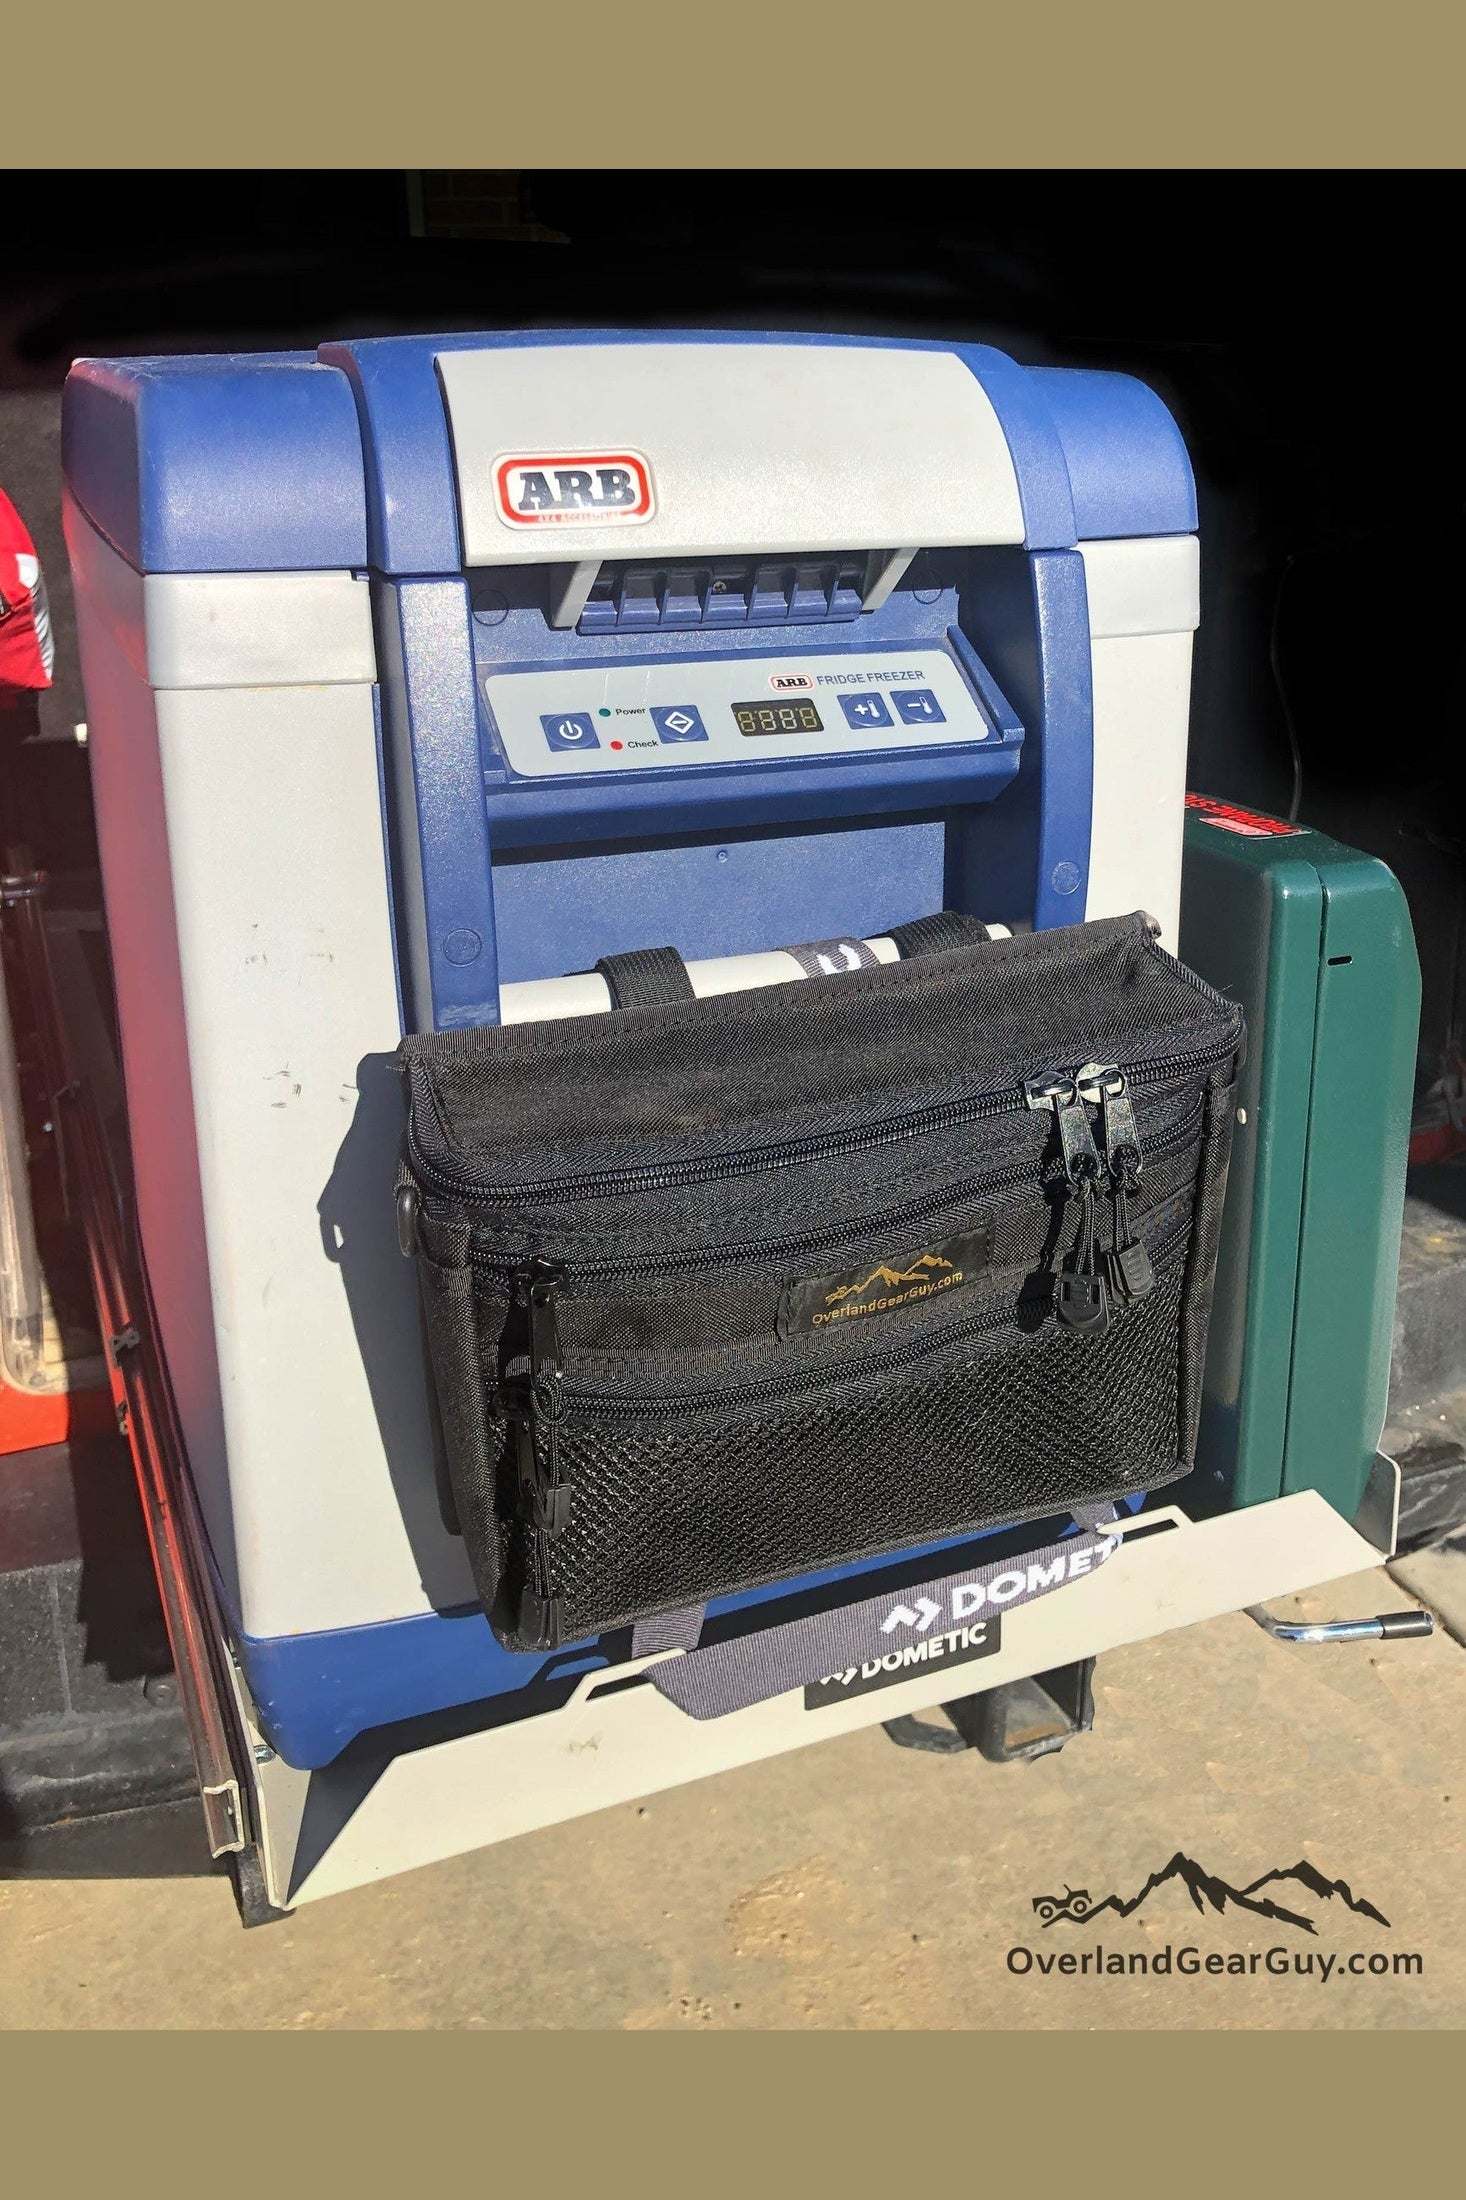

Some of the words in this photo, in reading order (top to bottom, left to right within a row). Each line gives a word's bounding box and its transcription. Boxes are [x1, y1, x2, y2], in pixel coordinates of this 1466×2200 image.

[518, 469, 636, 511] ARB
[776, 676, 808, 688] ARB
[816, 673, 868, 686] FRIDGE
[868, 670, 925, 683] FREEZER
[615, 707, 646, 716] Power
[627, 739, 659, 749] Check
[812, 1270, 963, 1326] OverlandGearGuy.com
[861, 1622, 987, 1680] DOMETIC
